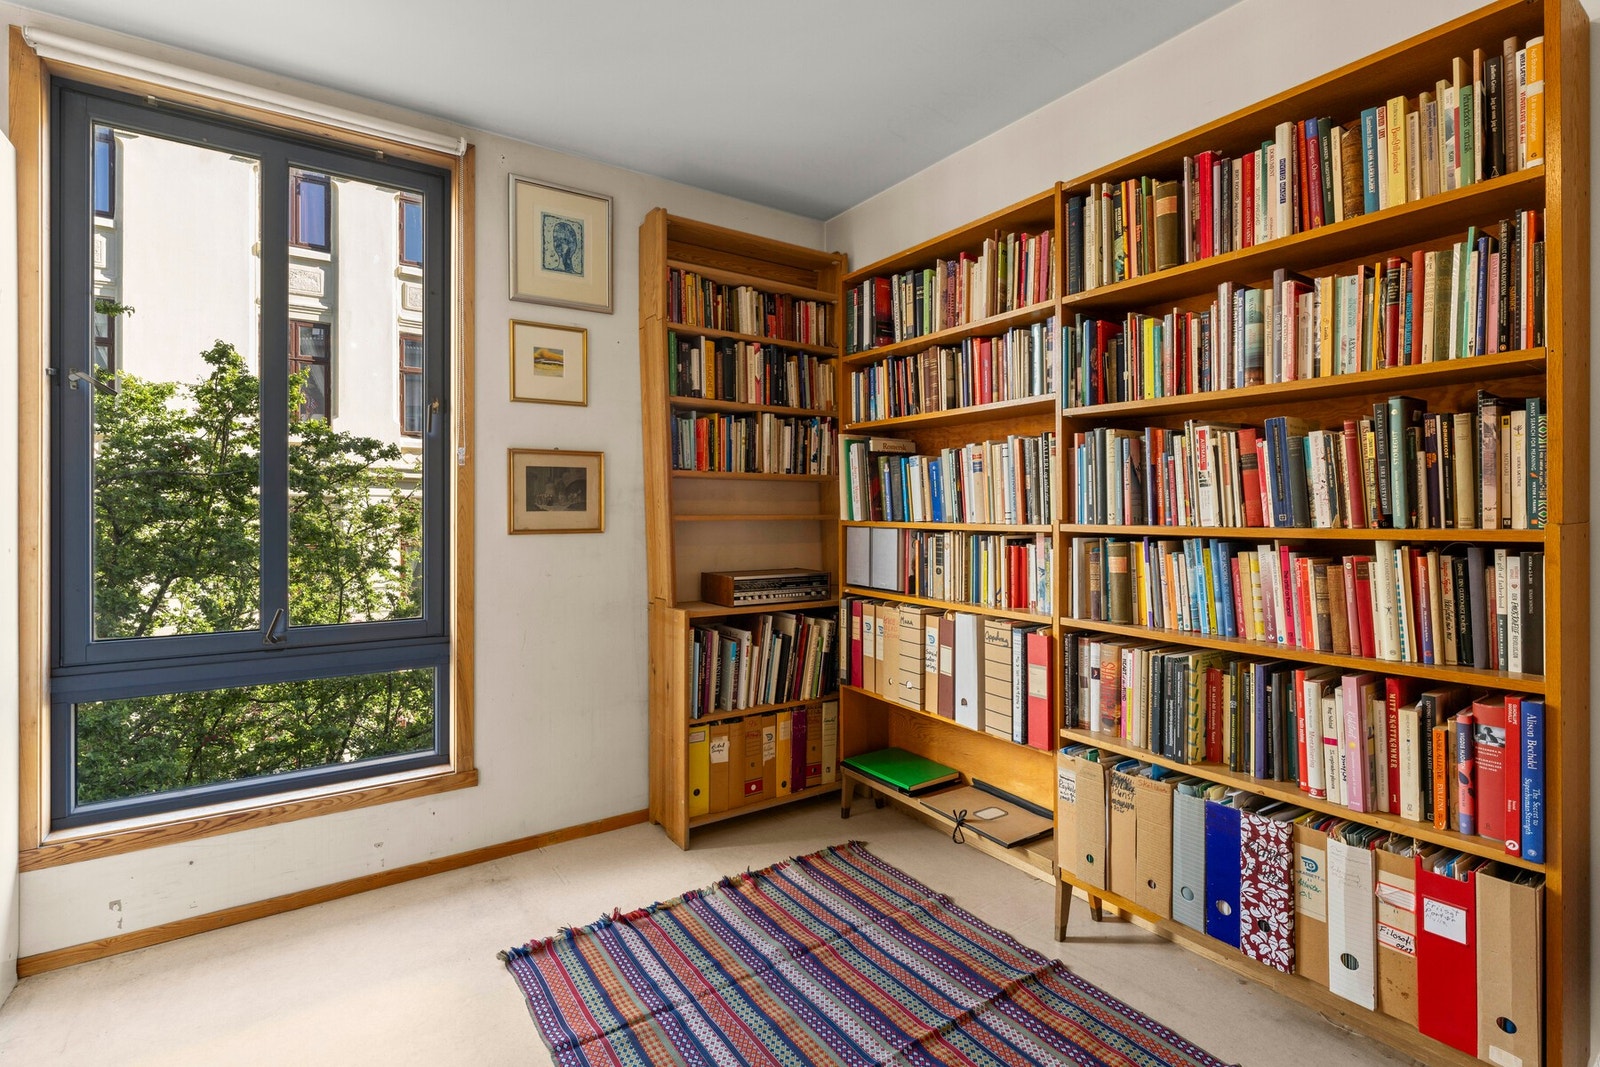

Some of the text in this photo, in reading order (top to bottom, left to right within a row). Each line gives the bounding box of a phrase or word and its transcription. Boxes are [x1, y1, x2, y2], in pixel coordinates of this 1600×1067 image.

[1311, 164, 1319, 180] Others
[1390, 714, 1398, 768] SKATTKAMMER
[1527, 713, 1538, 769] Alison Bechdel
[1436, 753, 1444, 779] ALLENDE
[1523, 778, 1533, 835] Superhuman Strength
[1532, 789, 1541, 800] The
[1533, 801, 1541, 819] Secret
